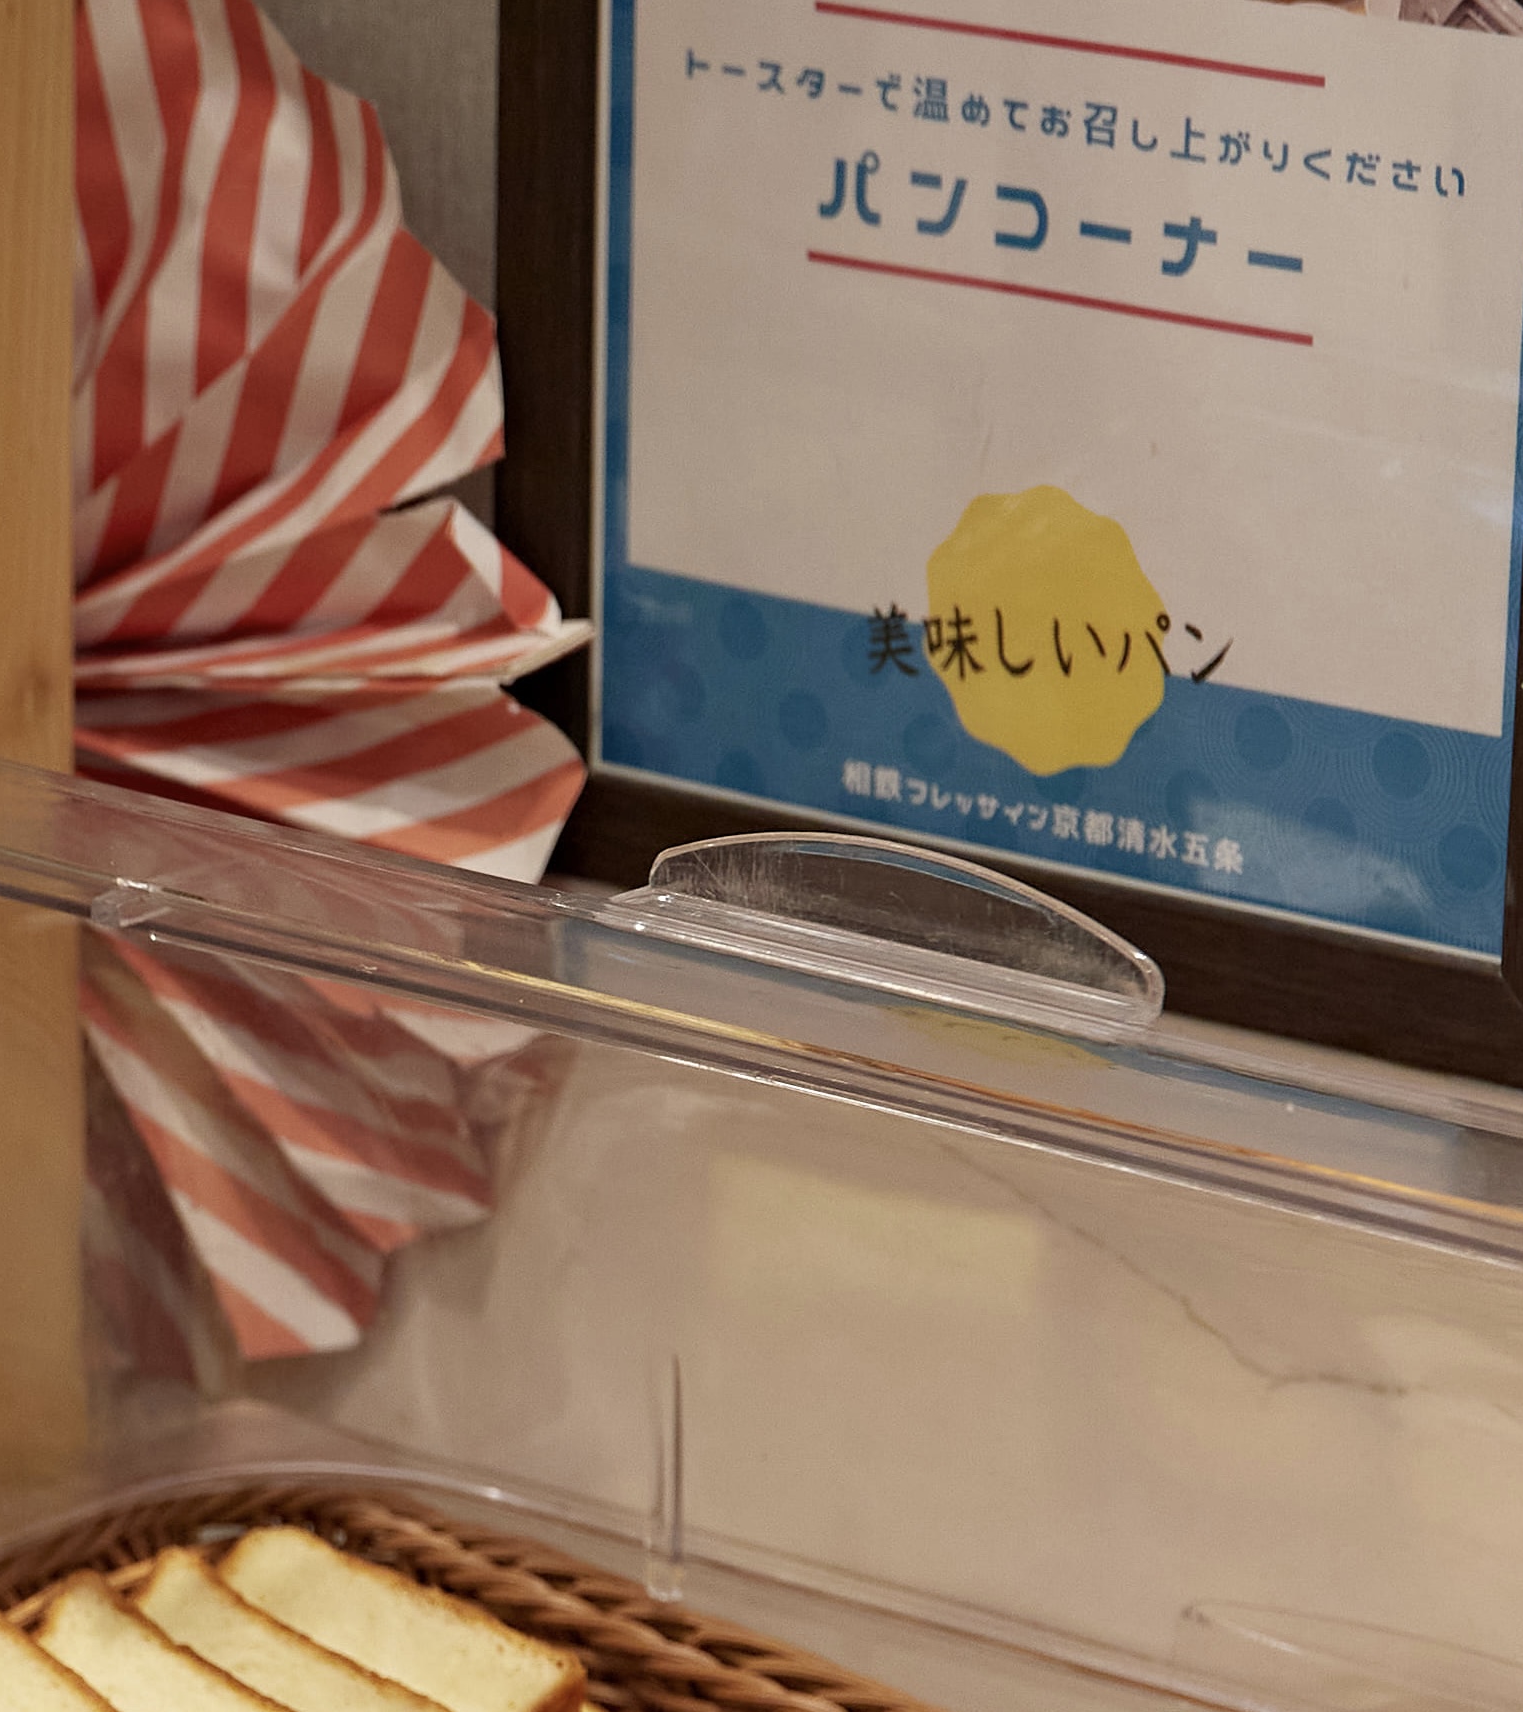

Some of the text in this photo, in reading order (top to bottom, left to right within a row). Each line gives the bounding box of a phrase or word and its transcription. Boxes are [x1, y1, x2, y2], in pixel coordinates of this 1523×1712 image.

[684, 48, 1468, 199] トースターで温めてお召し上がりください
[818, 150, 1305, 278] パンコーナー
[867, 602, 1234, 685] 美味しいパン
